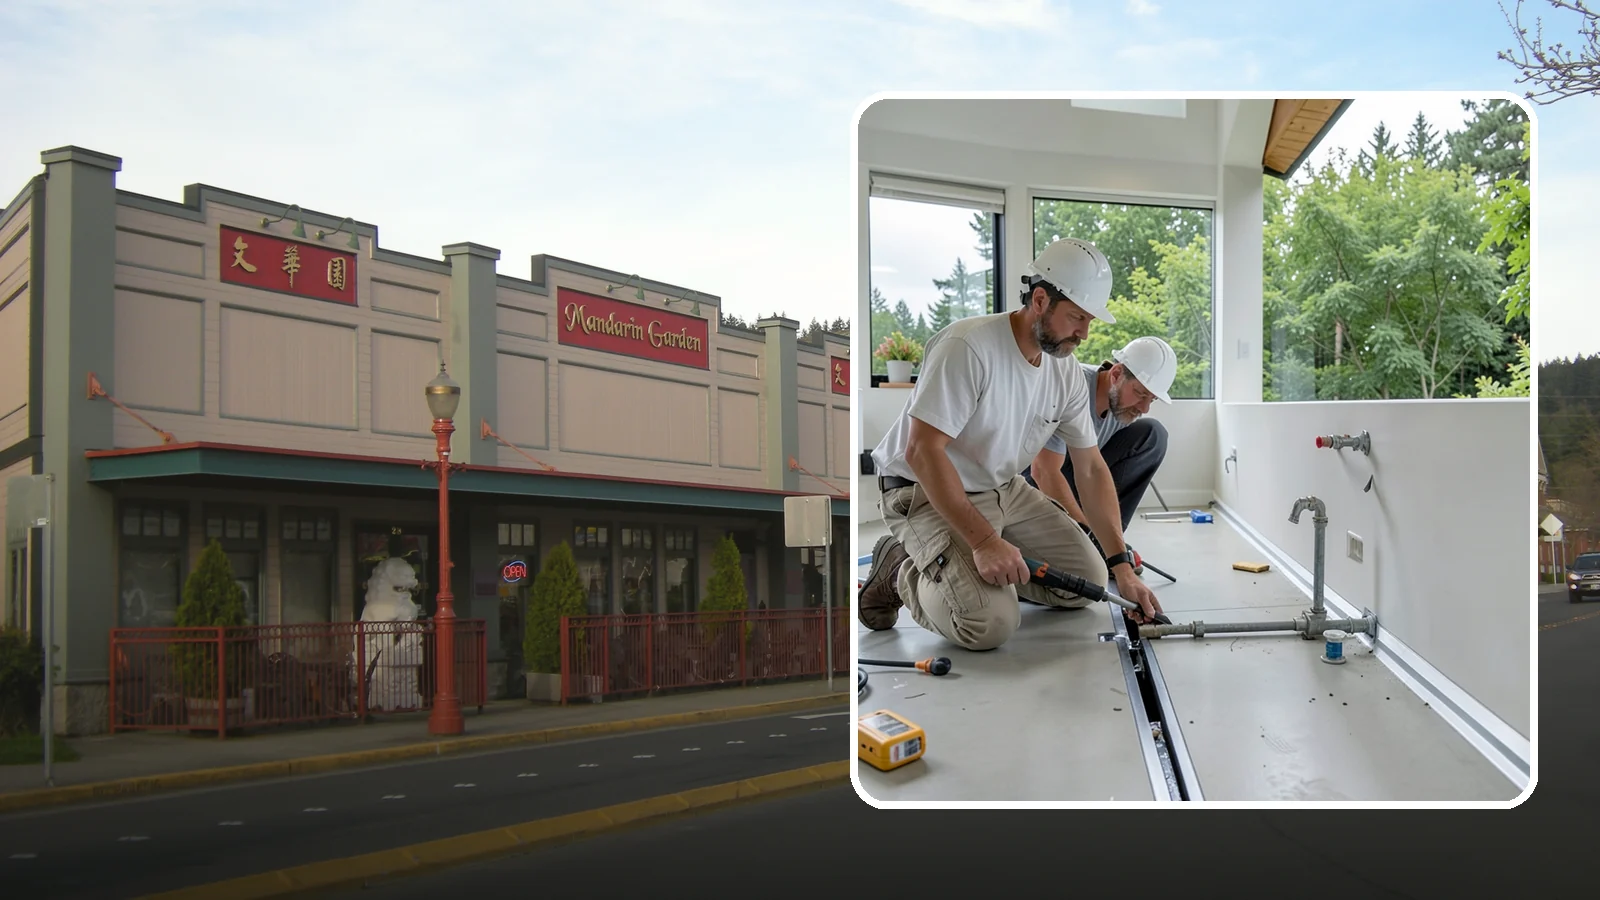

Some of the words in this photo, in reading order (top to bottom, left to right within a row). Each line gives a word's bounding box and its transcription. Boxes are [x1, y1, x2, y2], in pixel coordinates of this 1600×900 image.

[231, 235, 346, 291] 文華園
[564, 302, 644, 341] Mandarin
[648, 320, 702, 352] Garden
[834, 363, 847, 386] 文
[503, 565, 527, 578] OPEN
